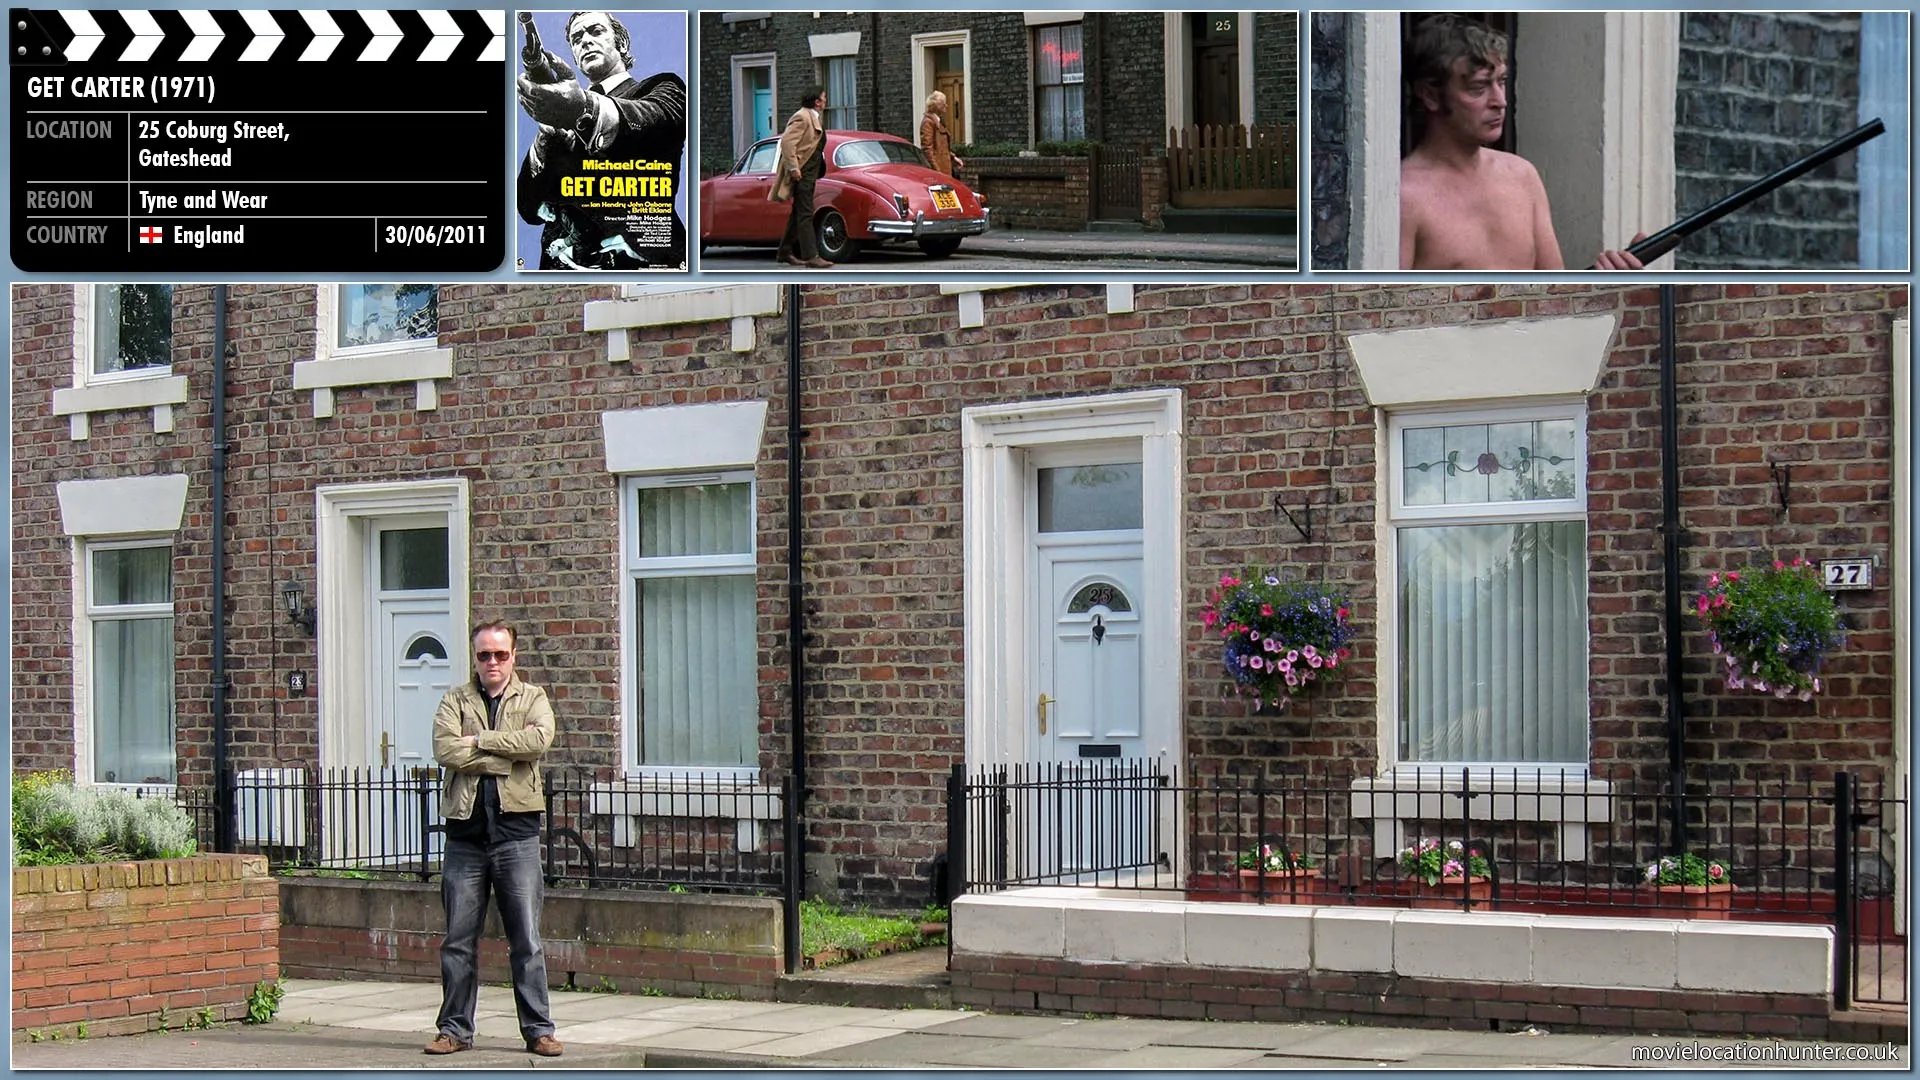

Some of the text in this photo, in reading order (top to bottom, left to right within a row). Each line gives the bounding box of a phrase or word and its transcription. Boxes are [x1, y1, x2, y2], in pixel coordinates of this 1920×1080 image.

[1215, 20, 1231, 31] 25
[583, 160, 672, 171] Michael Caine
[561, 176, 672, 197] GET CARTER
[1831, 565, 1861, 584] 27
[1088, 587, 1113, 605] 25
